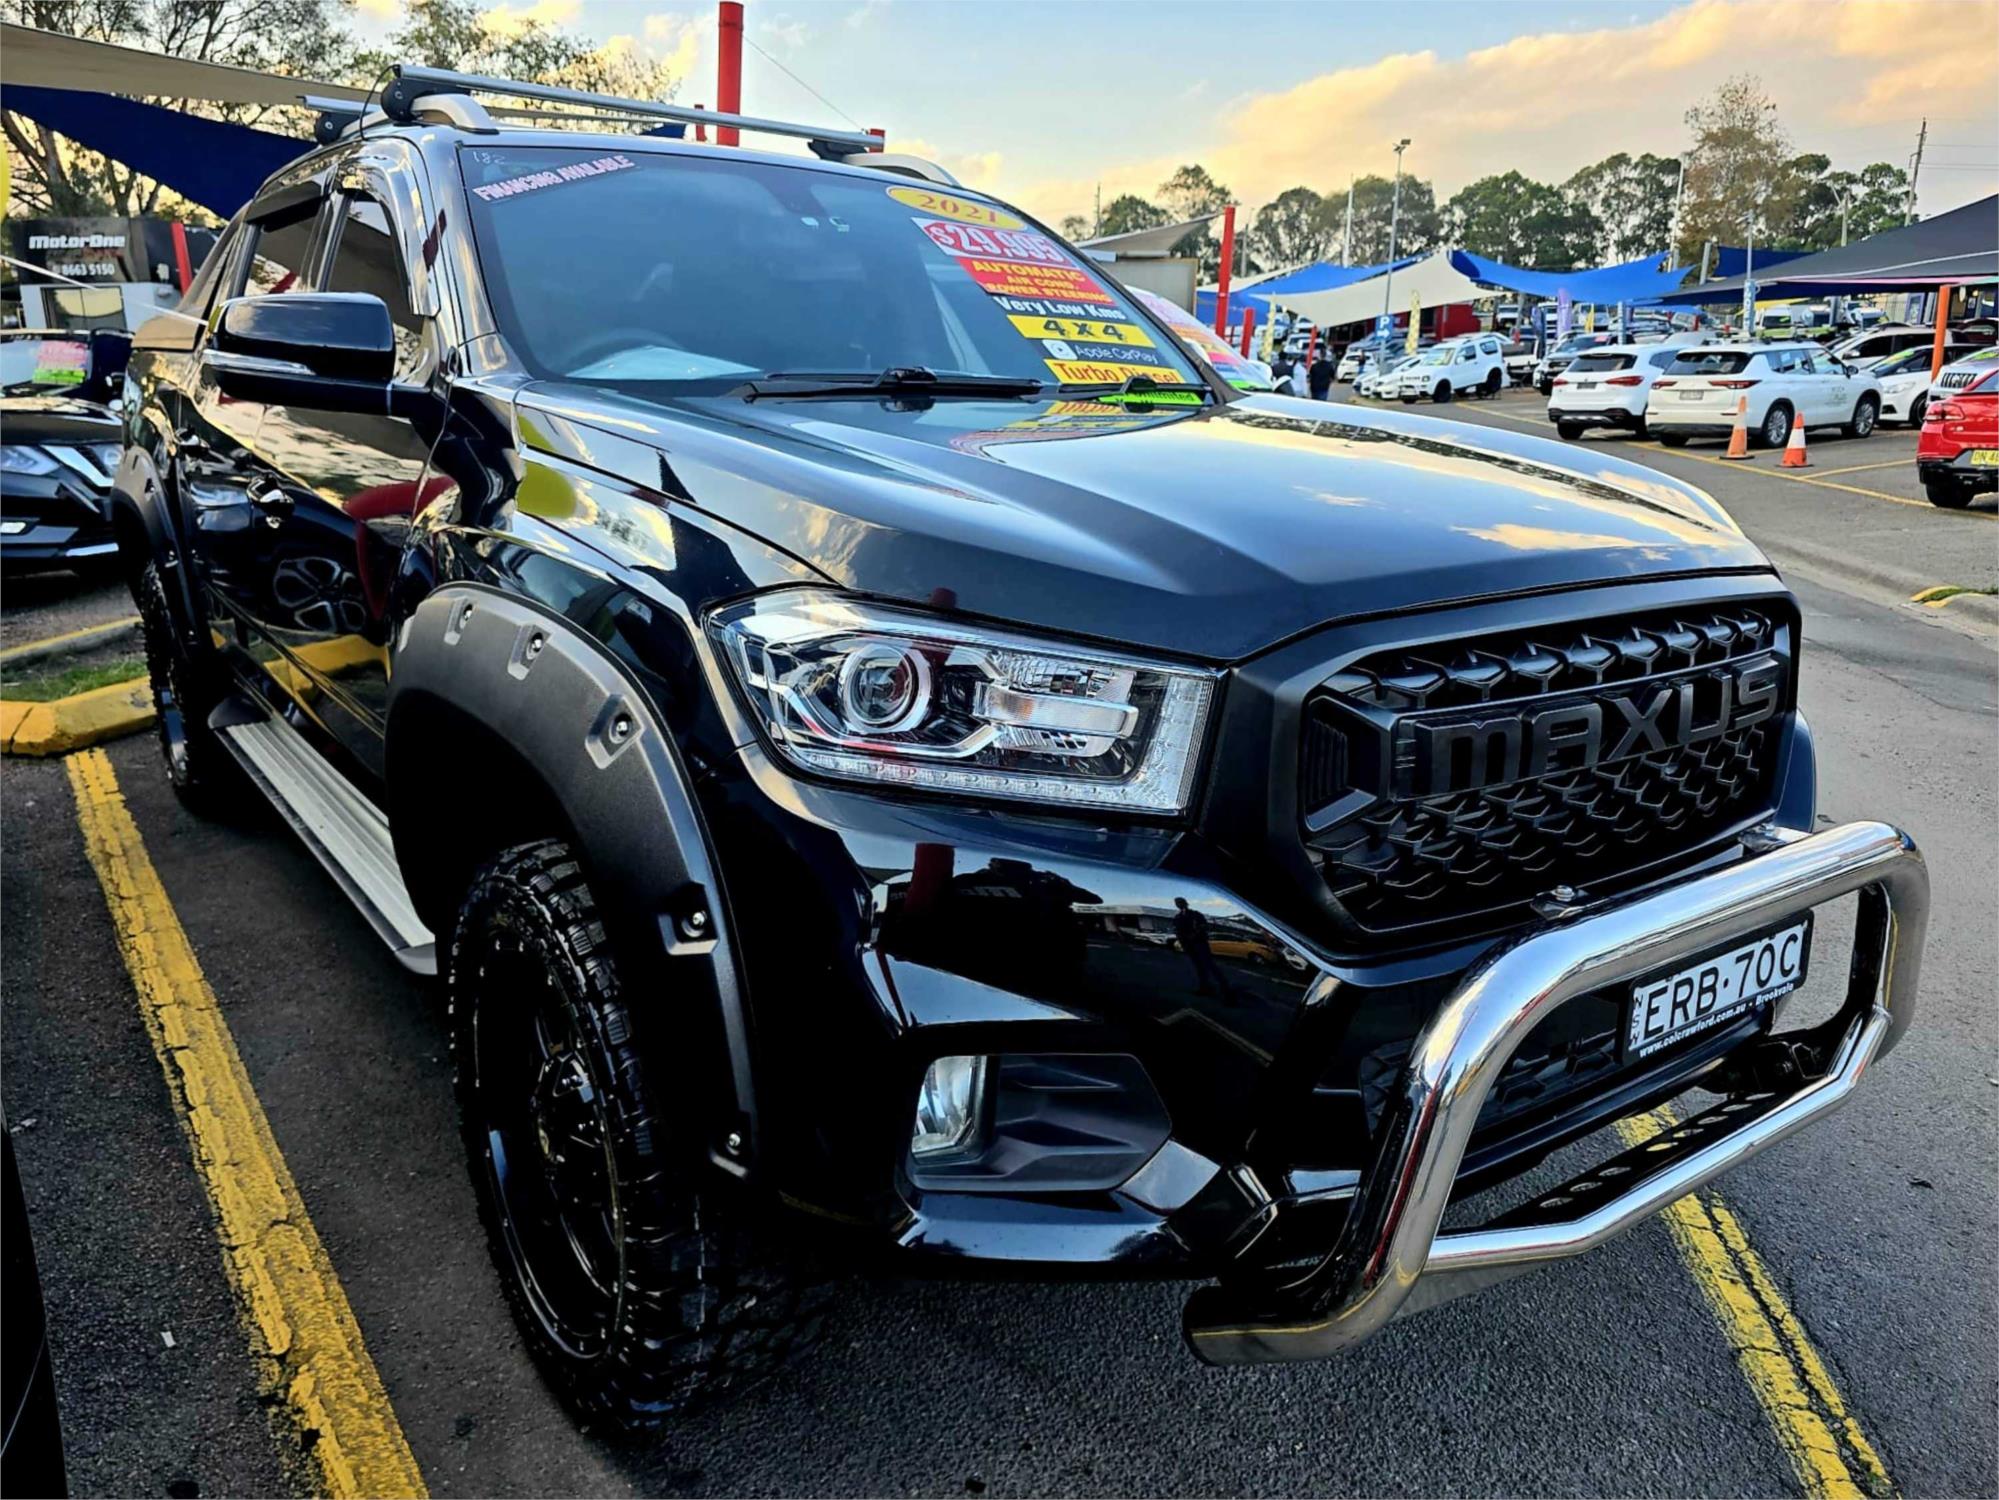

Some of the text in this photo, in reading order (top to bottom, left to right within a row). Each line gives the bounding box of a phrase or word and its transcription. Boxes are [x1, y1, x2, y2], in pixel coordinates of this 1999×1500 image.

[472, 155, 635, 201] FINANCING AVAILABLE
[916, 194, 997, 223] 2021
[29, 234, 125, 249] MotorOne
[971, 260, 1087, 282] AUTOMATIC
[993, 296, 1047, 316] Very
[1043, 300, 1086, 316] Low
[1041, 287, 1113, 304] STEERING
[1379, 316, 1390, 329] P
[1074, 344, 1159, 365] Apple CarPlay
[1054, 363, 1180, 384] Turbo Disel
[1415, 656, 1783, 795] MAXUS
[1639, 1002, 1747, 1058] www.colcrawford.com.au
